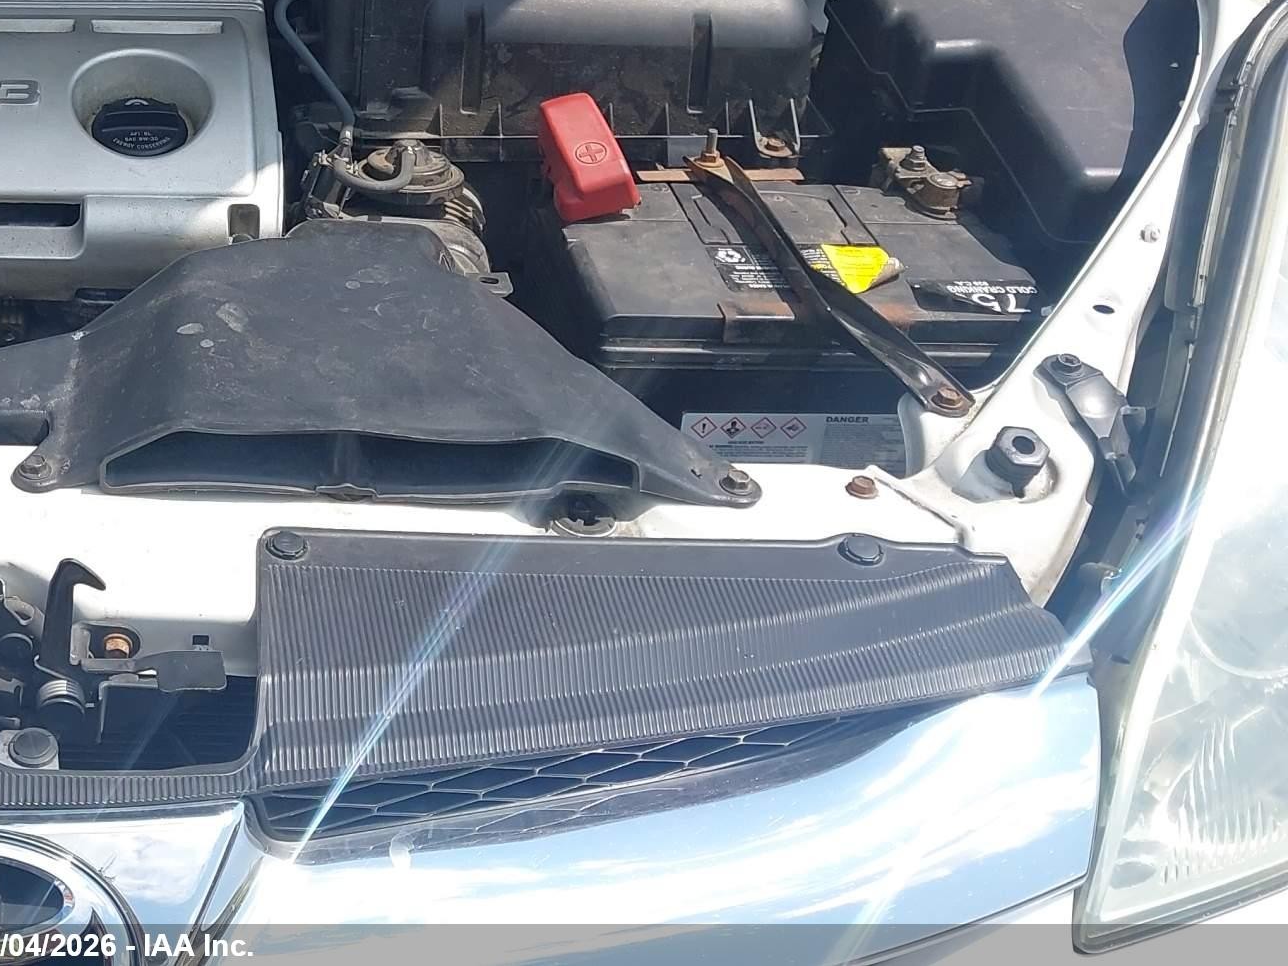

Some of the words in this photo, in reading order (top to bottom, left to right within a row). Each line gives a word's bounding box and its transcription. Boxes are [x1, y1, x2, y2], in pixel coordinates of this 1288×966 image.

[112, 137, 135, 149] ENERGY
[136, 136, 171, 151] CONSERVING
[945, 284, 1006, 294] CRANKING
[1005, 285, 1038, 294] COLD
[955, 293, 1032, 313] 75
